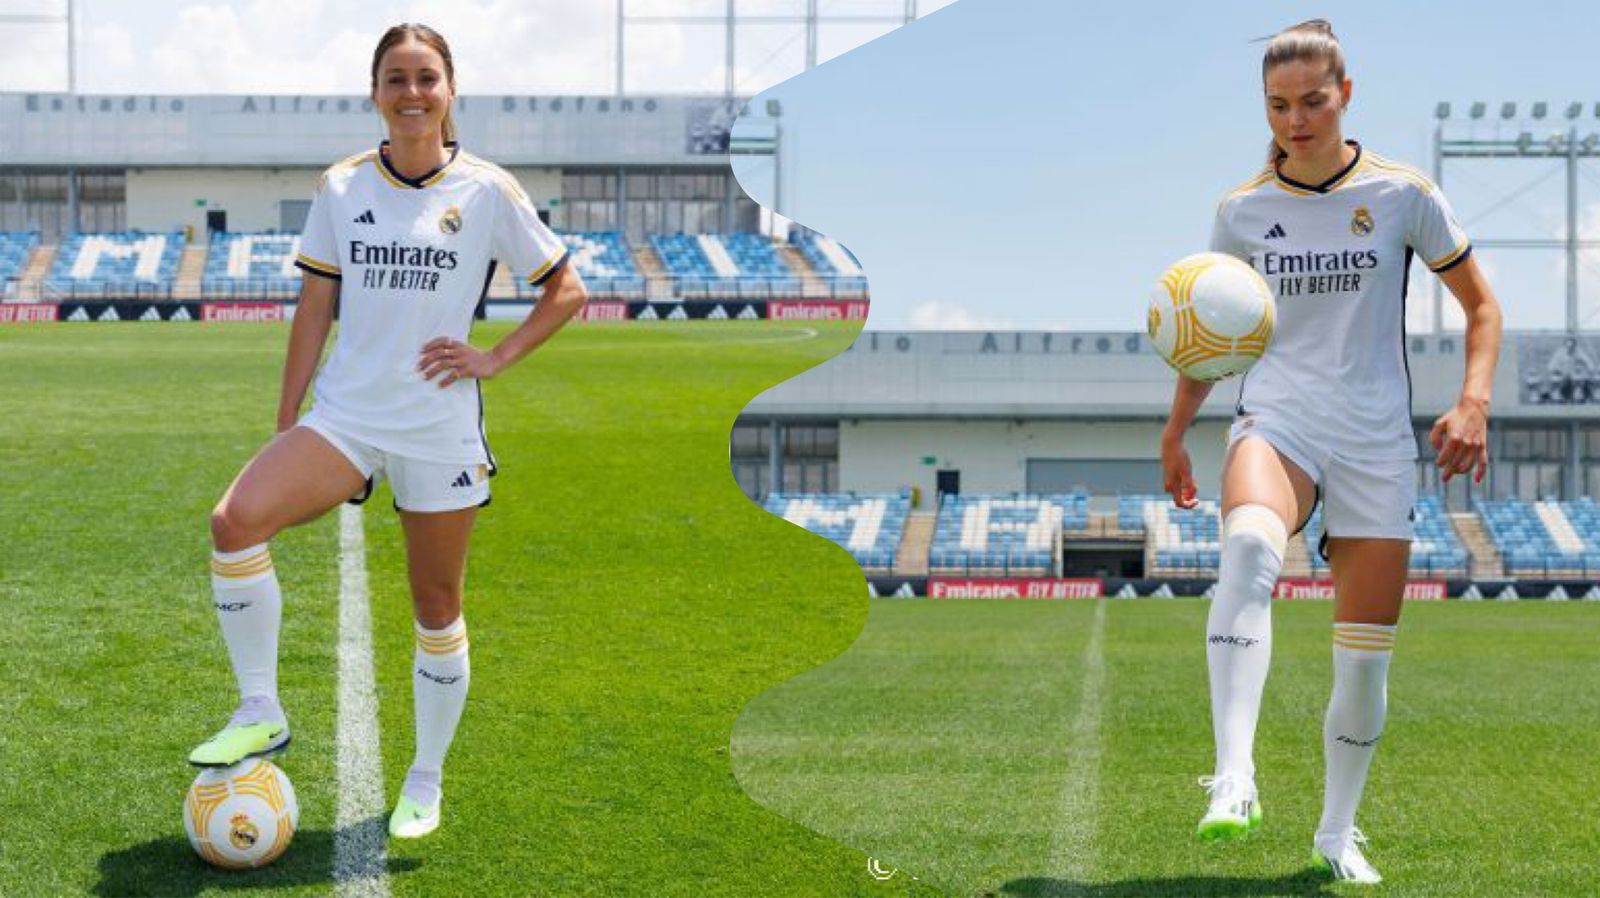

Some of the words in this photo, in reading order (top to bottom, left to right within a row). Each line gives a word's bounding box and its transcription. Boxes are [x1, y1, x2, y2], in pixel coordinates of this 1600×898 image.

[25, 95, 184, 112] Estadio
[350, 240, 458, 270] Emirates
[1264, 249, 1378, 275] Emirates
[363, 268, 386, 289] FLY
[389, 269, 440, 291] BETTER
[1280, 277, 1303, 296] FLY
[1307, 274, 1361, 294] BETTER
[931, 580, 1021, 600] Emirates
